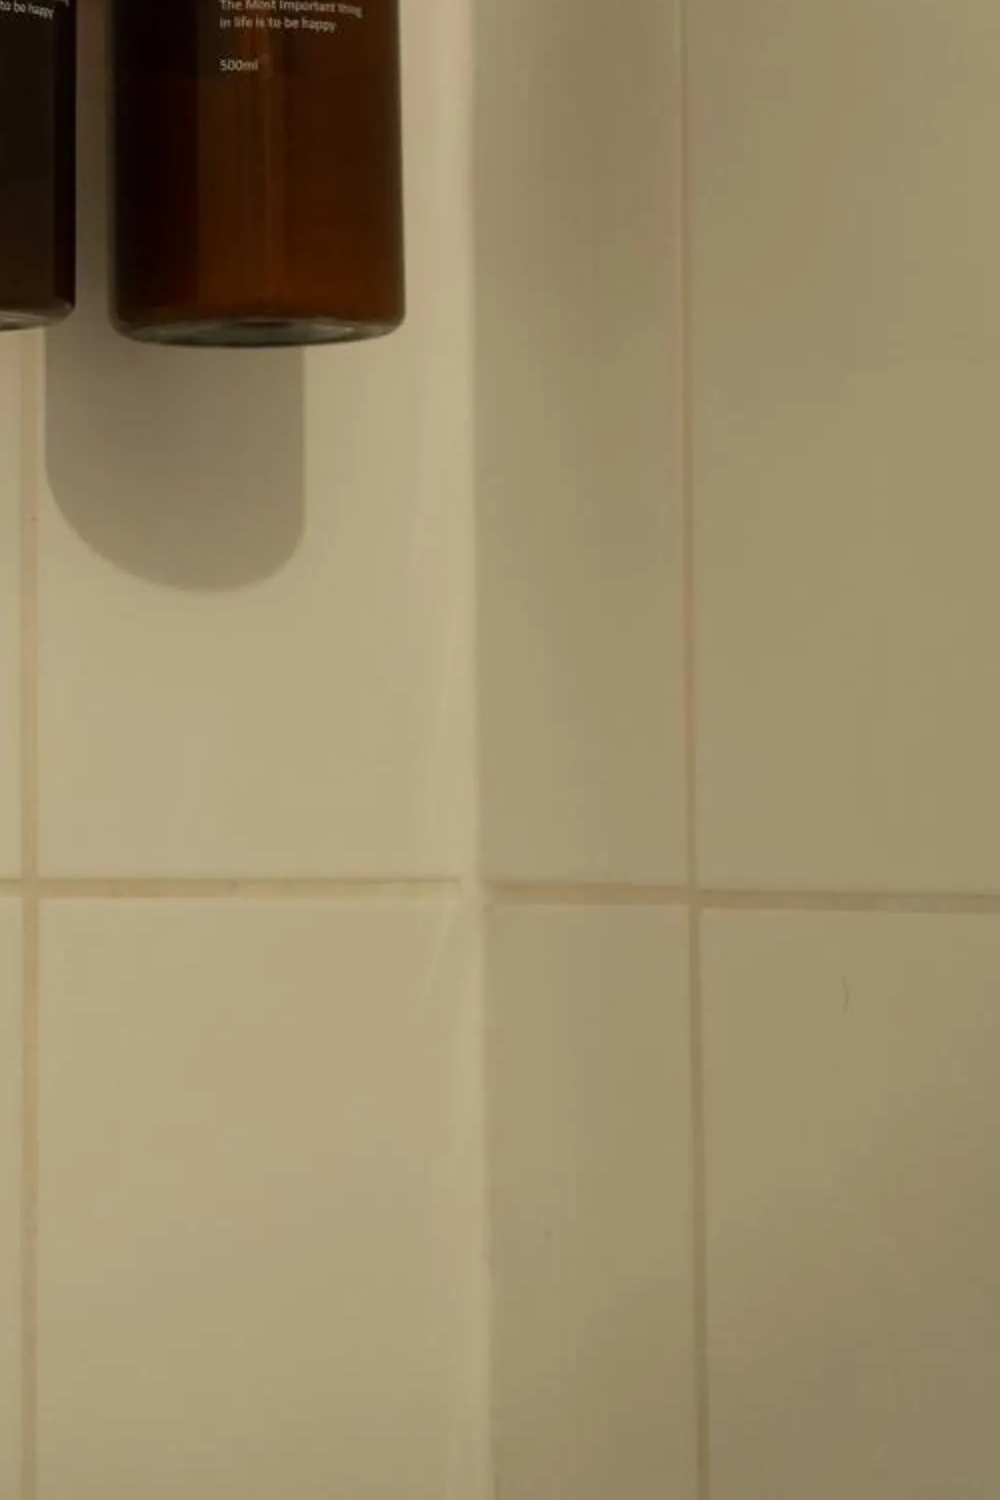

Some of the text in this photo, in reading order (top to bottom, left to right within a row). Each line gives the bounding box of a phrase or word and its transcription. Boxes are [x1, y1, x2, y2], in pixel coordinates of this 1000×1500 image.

[13, 1, 26, 13] be
[220, 0, 242, 11] The
[245, 0, 277, 11] Most
[233, 16, 253, 29] life
[255, 17, 265, 29] is
[268, 17, 281, 29] to
[283, 17, 299, 30] be
[301, 18, 337, 34] happy
[219, 59, 259, 72] 500ml
